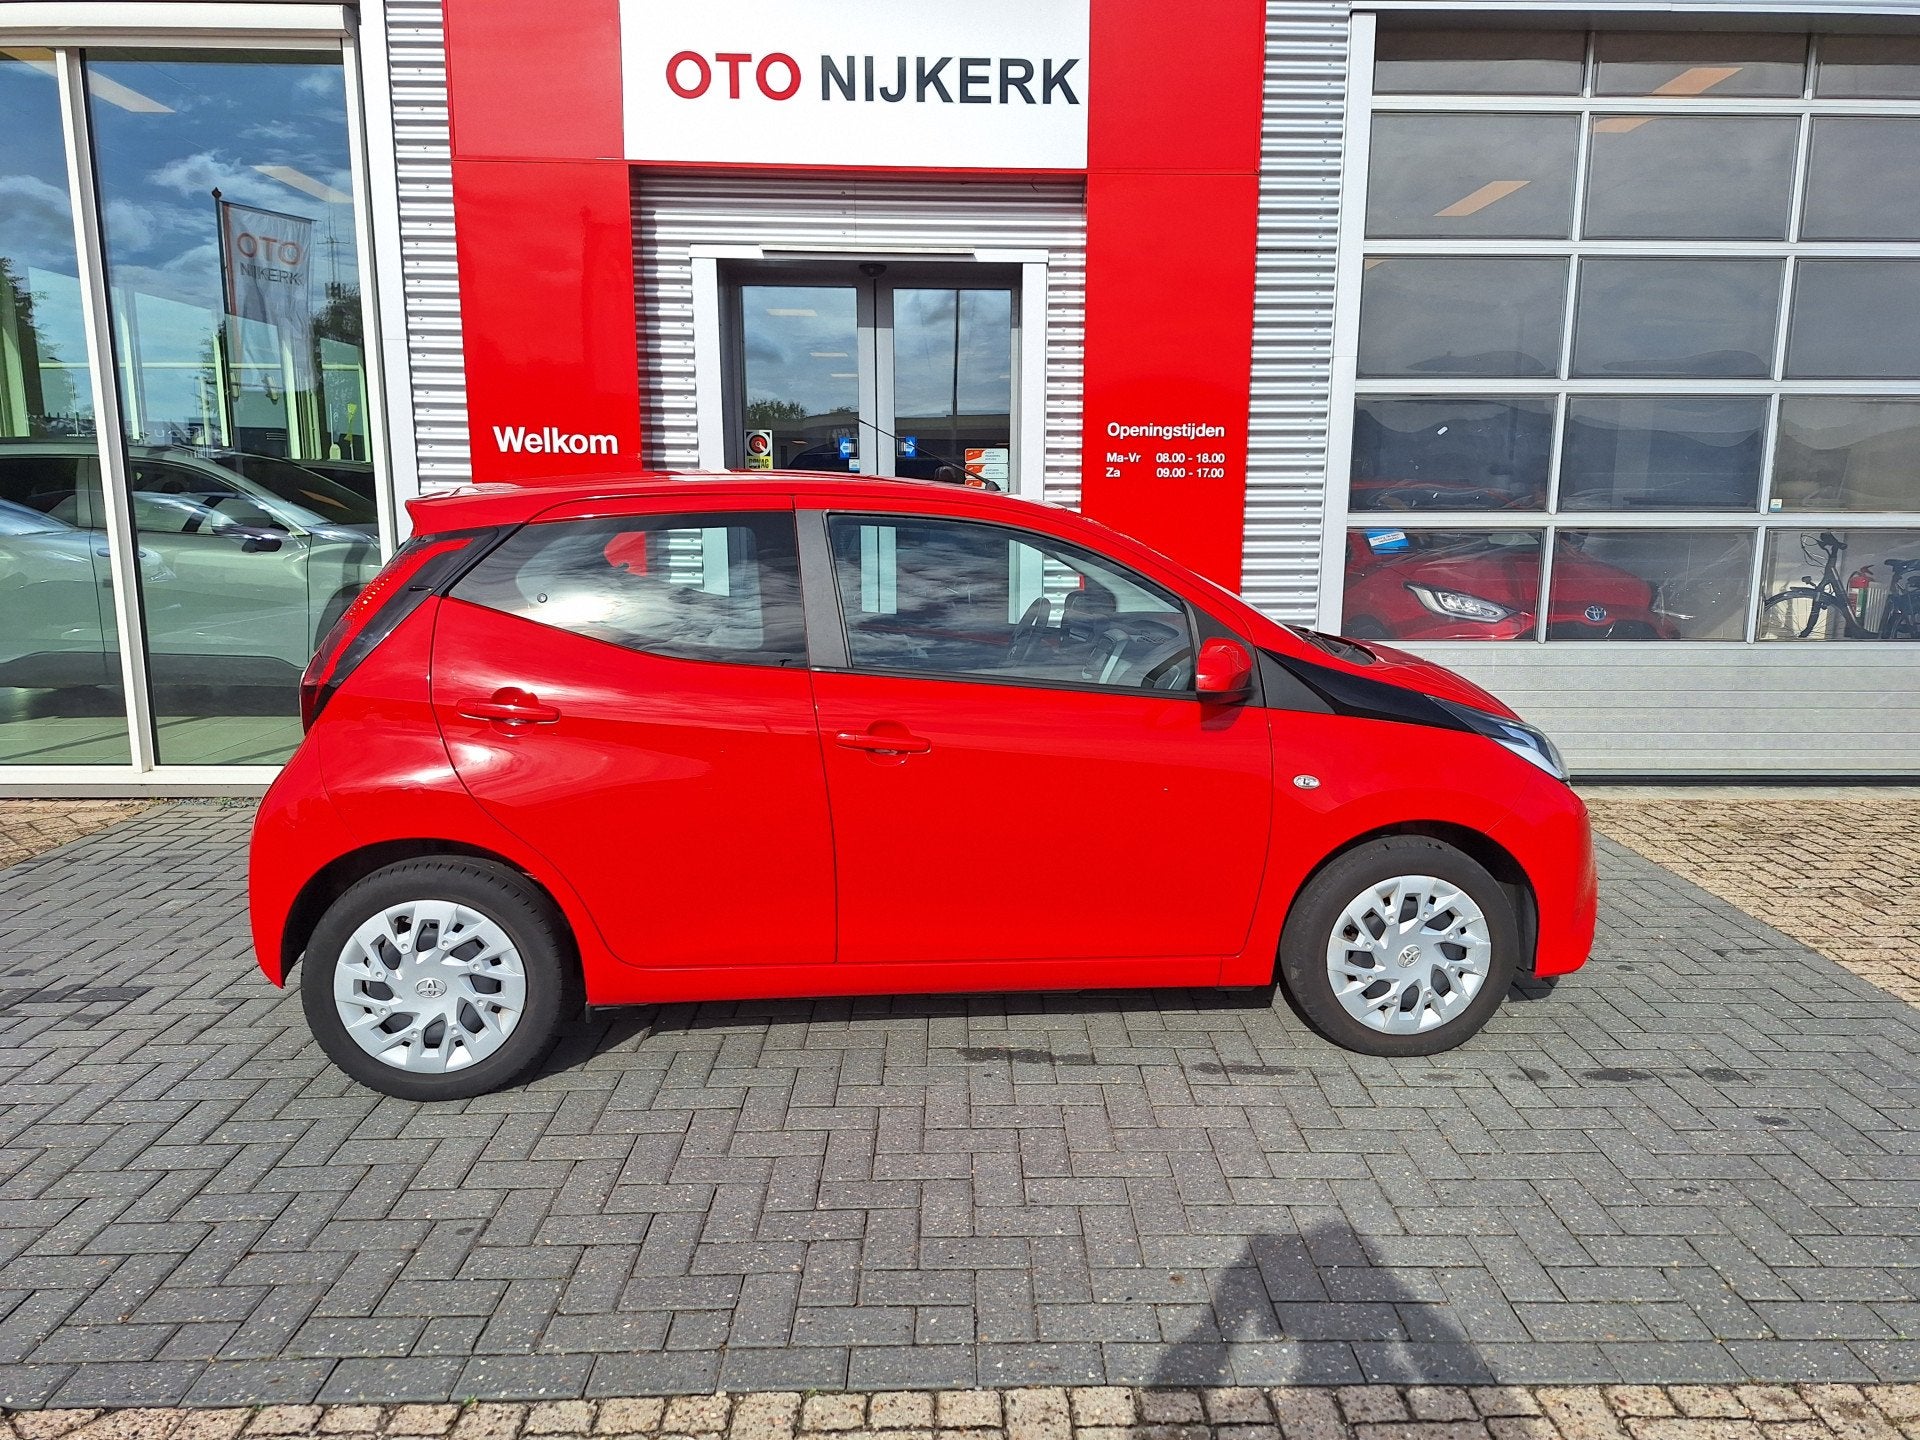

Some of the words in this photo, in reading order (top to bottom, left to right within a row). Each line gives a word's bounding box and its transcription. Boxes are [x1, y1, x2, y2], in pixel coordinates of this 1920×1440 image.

[666, 50, 801, 101] OTO
[820, 54, 1081, 105] NIJKERK
[237, 232, 303, 266] OTO
[492, 426, 618, 454] Welkom
[1107, 422, 1225, 440] Openingstijden
[1106, 452, 1141, 463] Ma-Vr
[1156, 453, 1185, 463] 08.00
[1196, 453, 1225, 463] 18.00
[1105, 467, 1121, 478] Za
[1156, 468, 1185, 478] 09.00
[1196, 468, 1225, 478] 17.00
